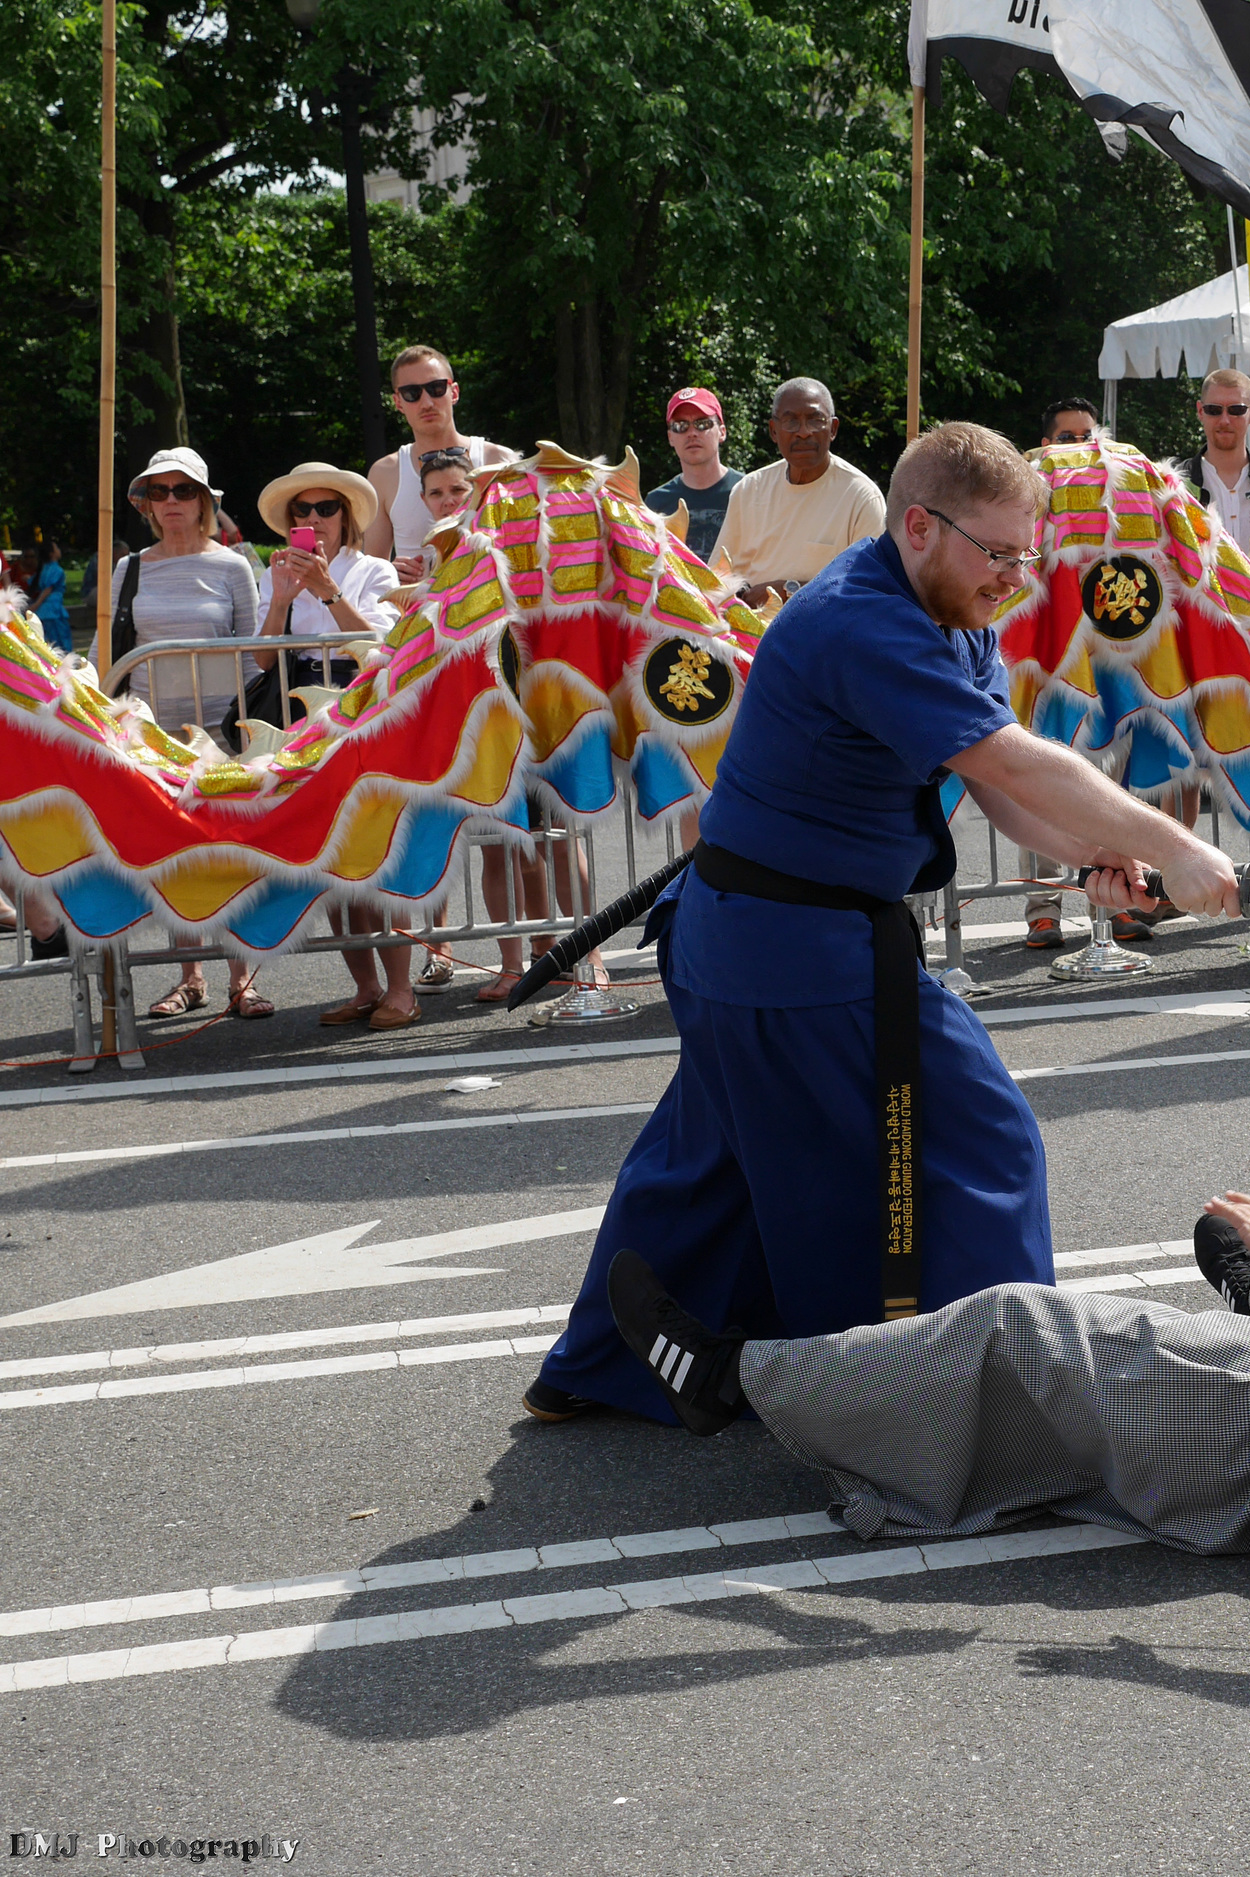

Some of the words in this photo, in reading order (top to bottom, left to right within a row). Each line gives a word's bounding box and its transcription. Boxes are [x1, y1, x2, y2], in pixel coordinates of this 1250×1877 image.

[901, 1084, 911, 1117] WORLD
[901, 1119, 912, 1160] HAIDONG
[902, 1162, 913, 1196] GUMDO
[902, 1198, 913, 1254] FEDERATION
